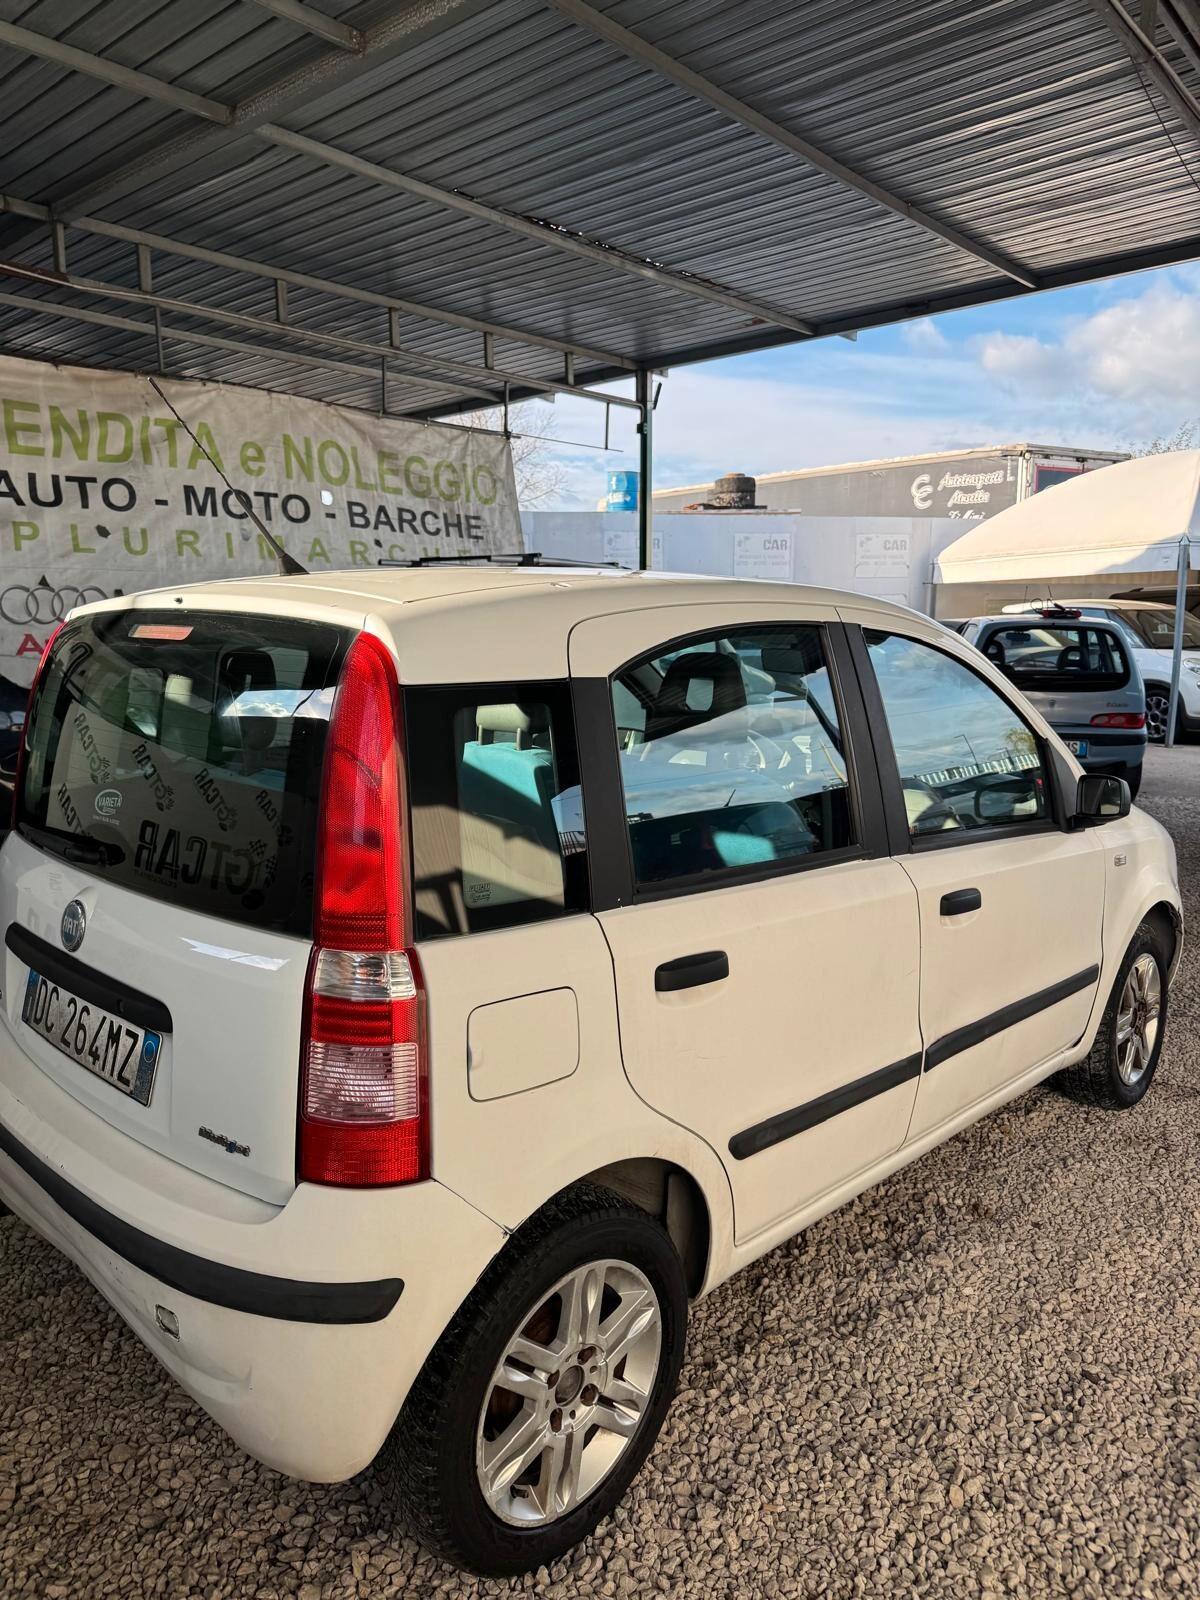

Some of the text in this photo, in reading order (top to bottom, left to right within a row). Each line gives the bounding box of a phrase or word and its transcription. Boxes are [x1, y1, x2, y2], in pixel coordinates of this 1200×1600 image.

[0, 470, 136, 512] AUTO
[183, 484, 310, 523] MOTO
[347, 500, 484, 540] BARCHE
[239, 440, 266, 476] e
[282, 433, 498, 506] NOLEGGIO
[33, 976, 140, 1086] DC 264MZ
